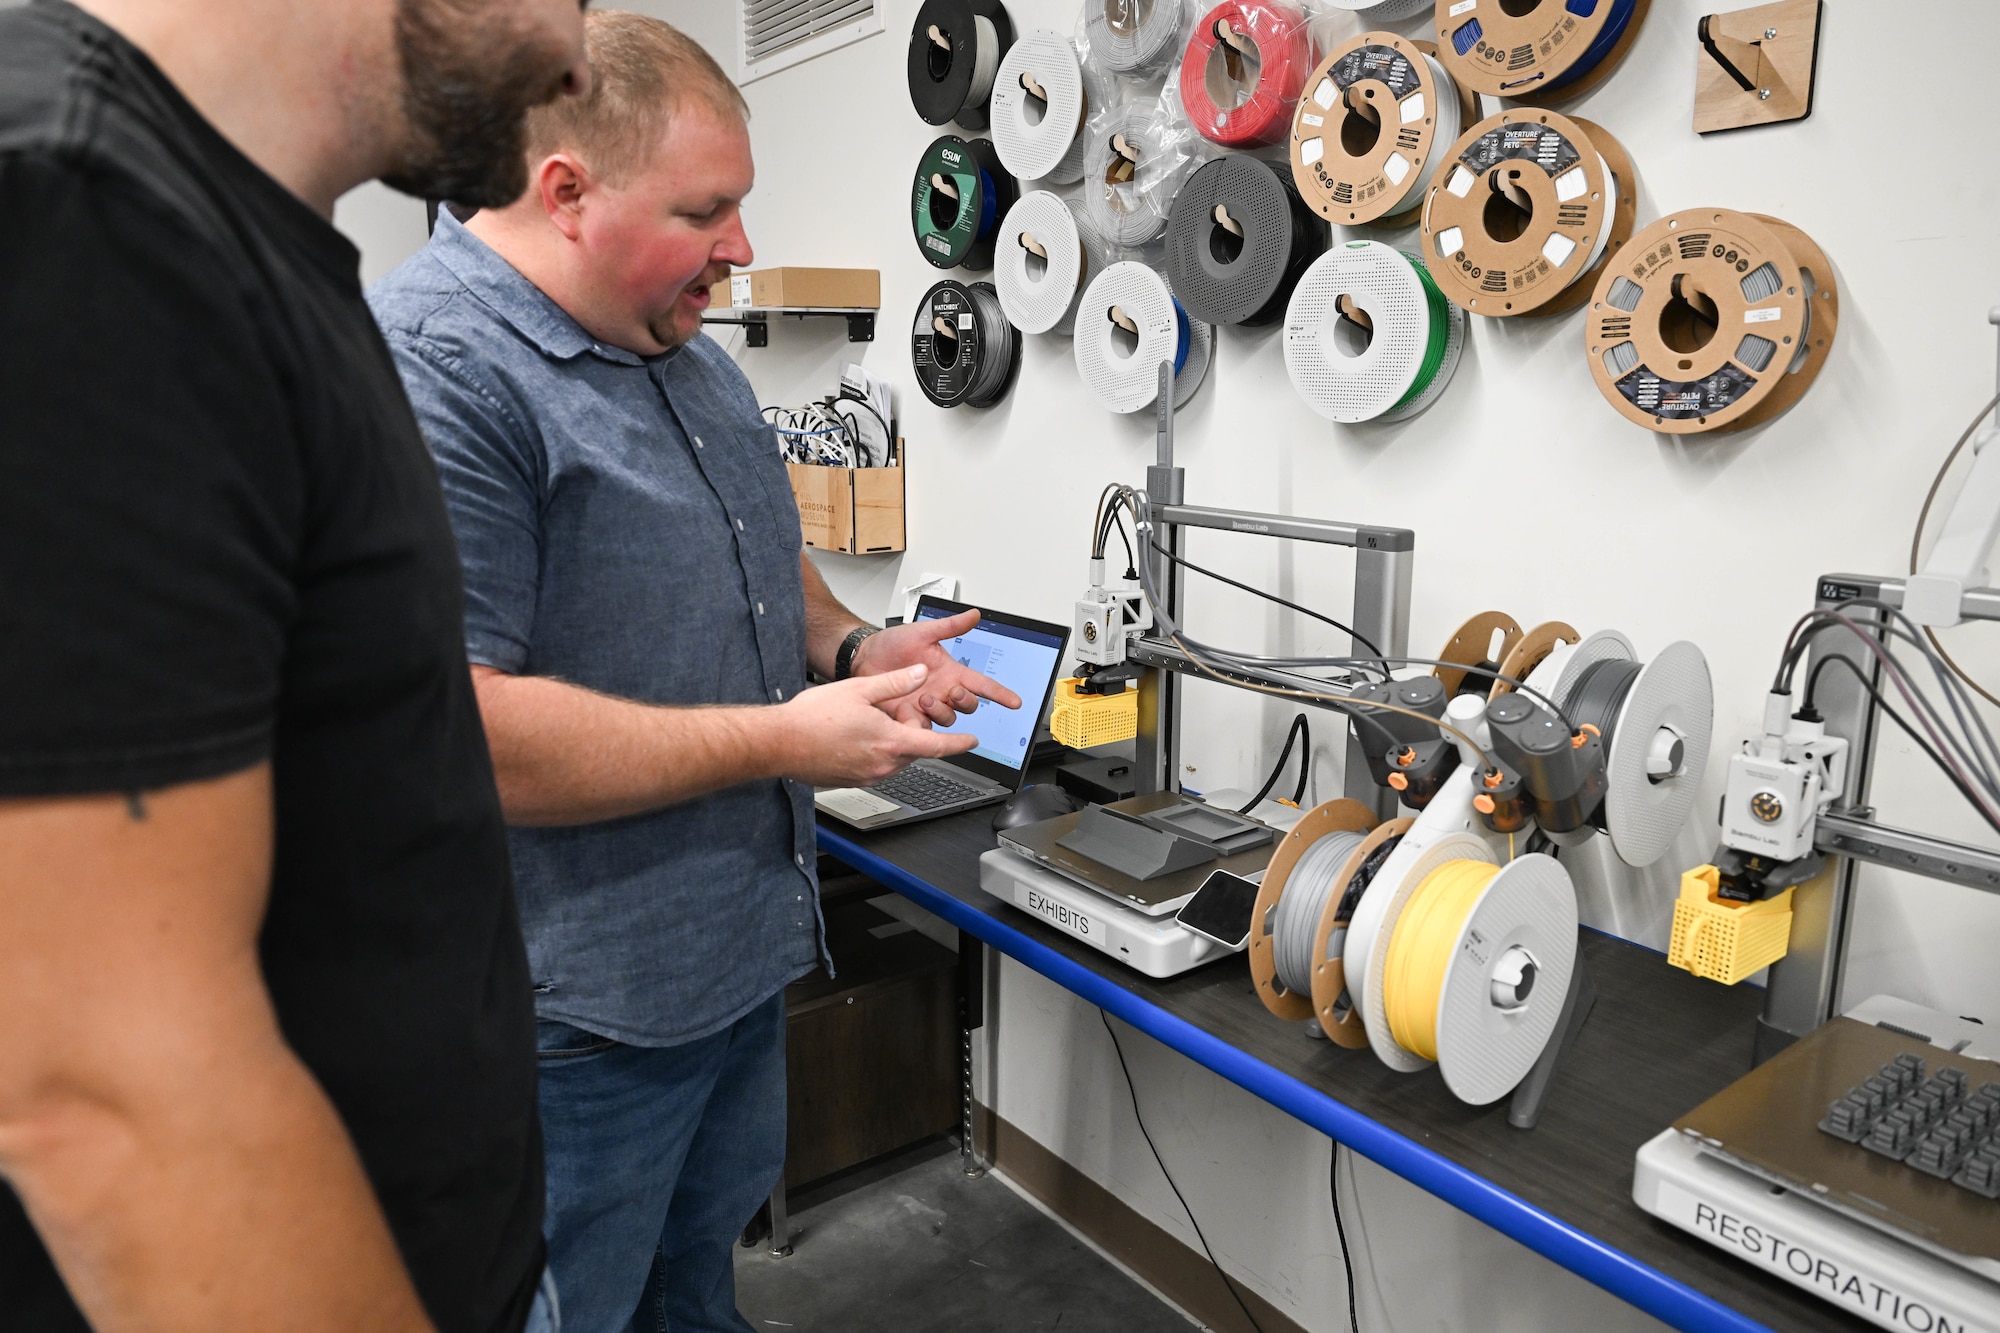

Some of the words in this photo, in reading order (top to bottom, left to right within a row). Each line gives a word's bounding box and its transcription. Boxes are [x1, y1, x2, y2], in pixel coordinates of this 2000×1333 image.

[1503, 141, 1520, 149] PETG
[800, 502, 835, 514] AEROSPACE
[1232, 520, 1255, 530] Bambu
[1256, 524, 1268, 532] Lab
[1731, 828, 1761, 841] Bambu
[1763, 837, 1780, 846] Lab
[1028, 891, 1089, 934] EXHIBITS
